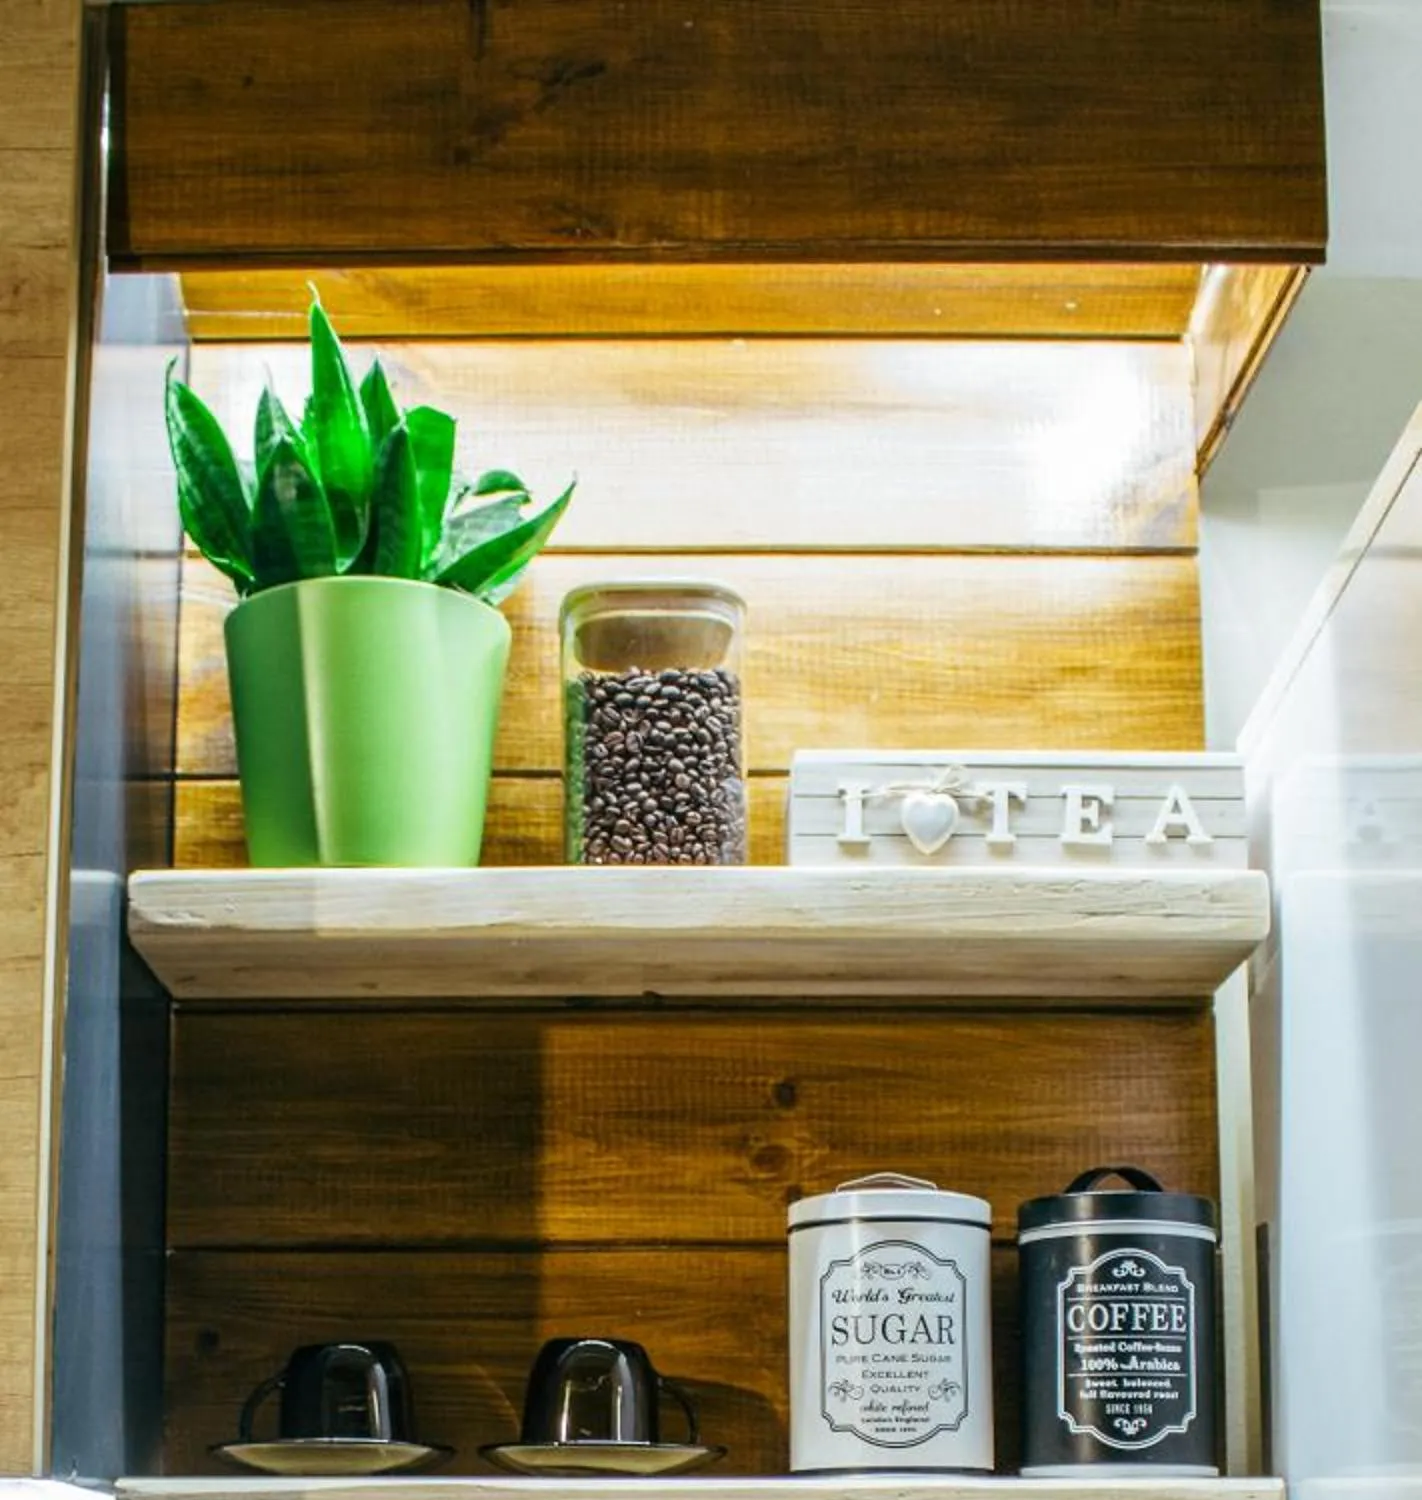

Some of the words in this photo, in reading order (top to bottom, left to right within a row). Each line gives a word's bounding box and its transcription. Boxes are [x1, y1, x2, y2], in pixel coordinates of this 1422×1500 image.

[837, 780, 871, 846] I
[974, 779, 1215, 846] TEA
[897, 1286, 956, 1305] Greatest
[1142, 1282, 1179, 1294] BLEND
[1067, 1302, 1187, 1333] COFFEE
[831, 1313, 955, 1347] SUGAR
[1080, 1357, 1119, 1372] 100%
[861, 1369, 930, 1380] EXCELLENT
[869, 1383, 921, 1394] QUALITY
